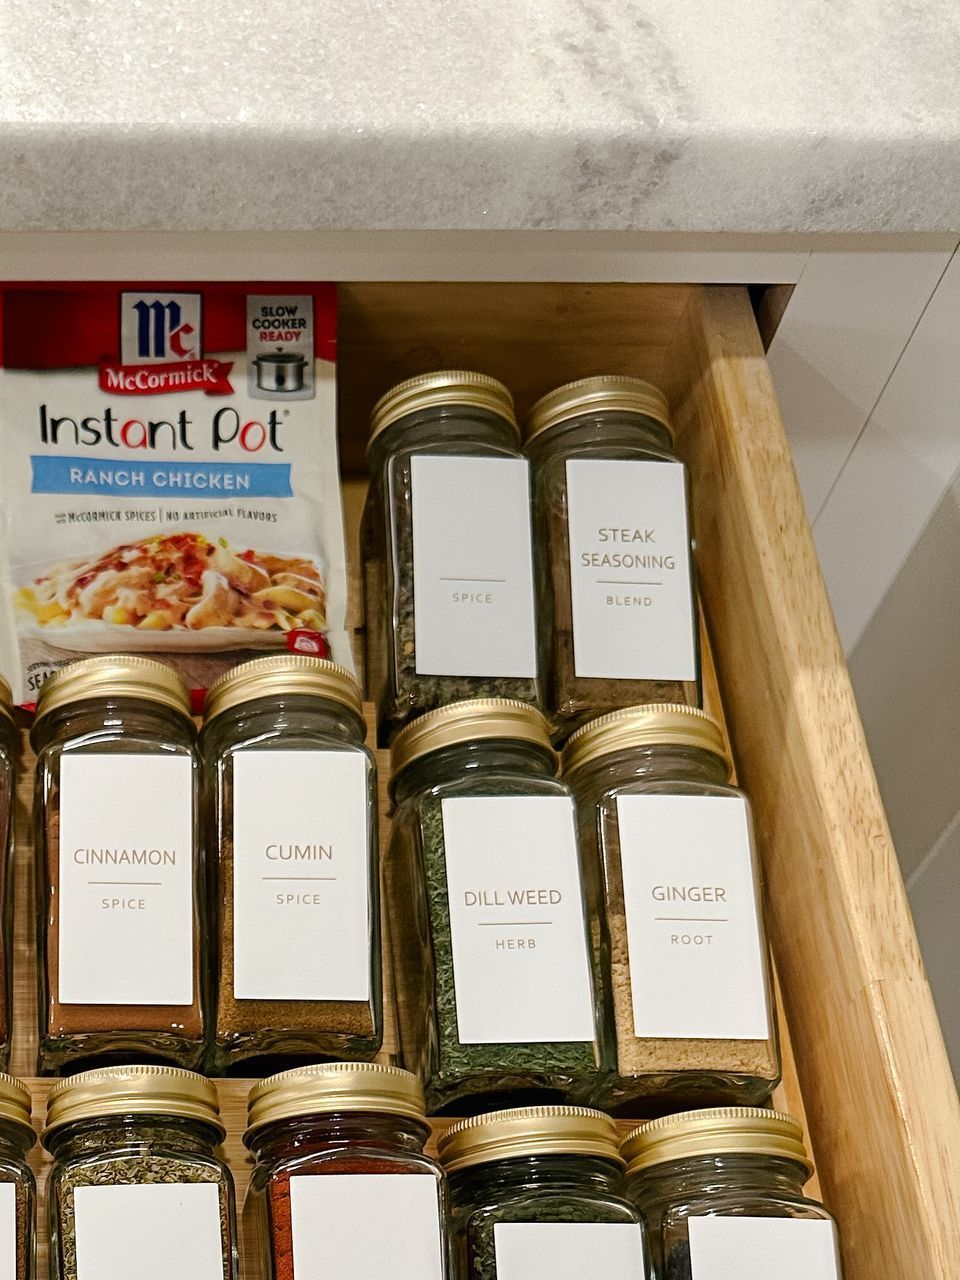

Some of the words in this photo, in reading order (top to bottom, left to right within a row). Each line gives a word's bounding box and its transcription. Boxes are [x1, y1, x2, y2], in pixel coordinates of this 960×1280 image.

[260, 306, 298, 317] SLOW
[252, 318, 307, 330] COOKER
[259, 331, 302, 342] READY
[106, 364, 218, 391] McCormick
[40, 404, 194, 451] Instant
[212, 406, 284, 452] Pot
[70, 467, 145, 488] RANCH
[152, 471, 251, 490] CHICKEN
[125, 510, 156, 522] SPICES
[166, 511, 180, 522] NO
[183, 508, 234, 520] ARTIFICIAL
[237, 508, 278, 523] FLAVORS
[598, 527, 656, 544] STEAK
[580, 551, 676, 570] SEASONING
[452, 592, 493, 604] SPICE
[605, 595, 653, 607] BLEND
[73, 848, 176, 866] CINNAMON
[265, 844, 333, 861] CUMIN
[276, 893, 321, 905] SPICE
[651, 885, 727, 903] GINGER
[101, 898, 146, 910] SPICE
[495, 937, 537, 951] HERB
[670, 934, 714, 946] ROOT
